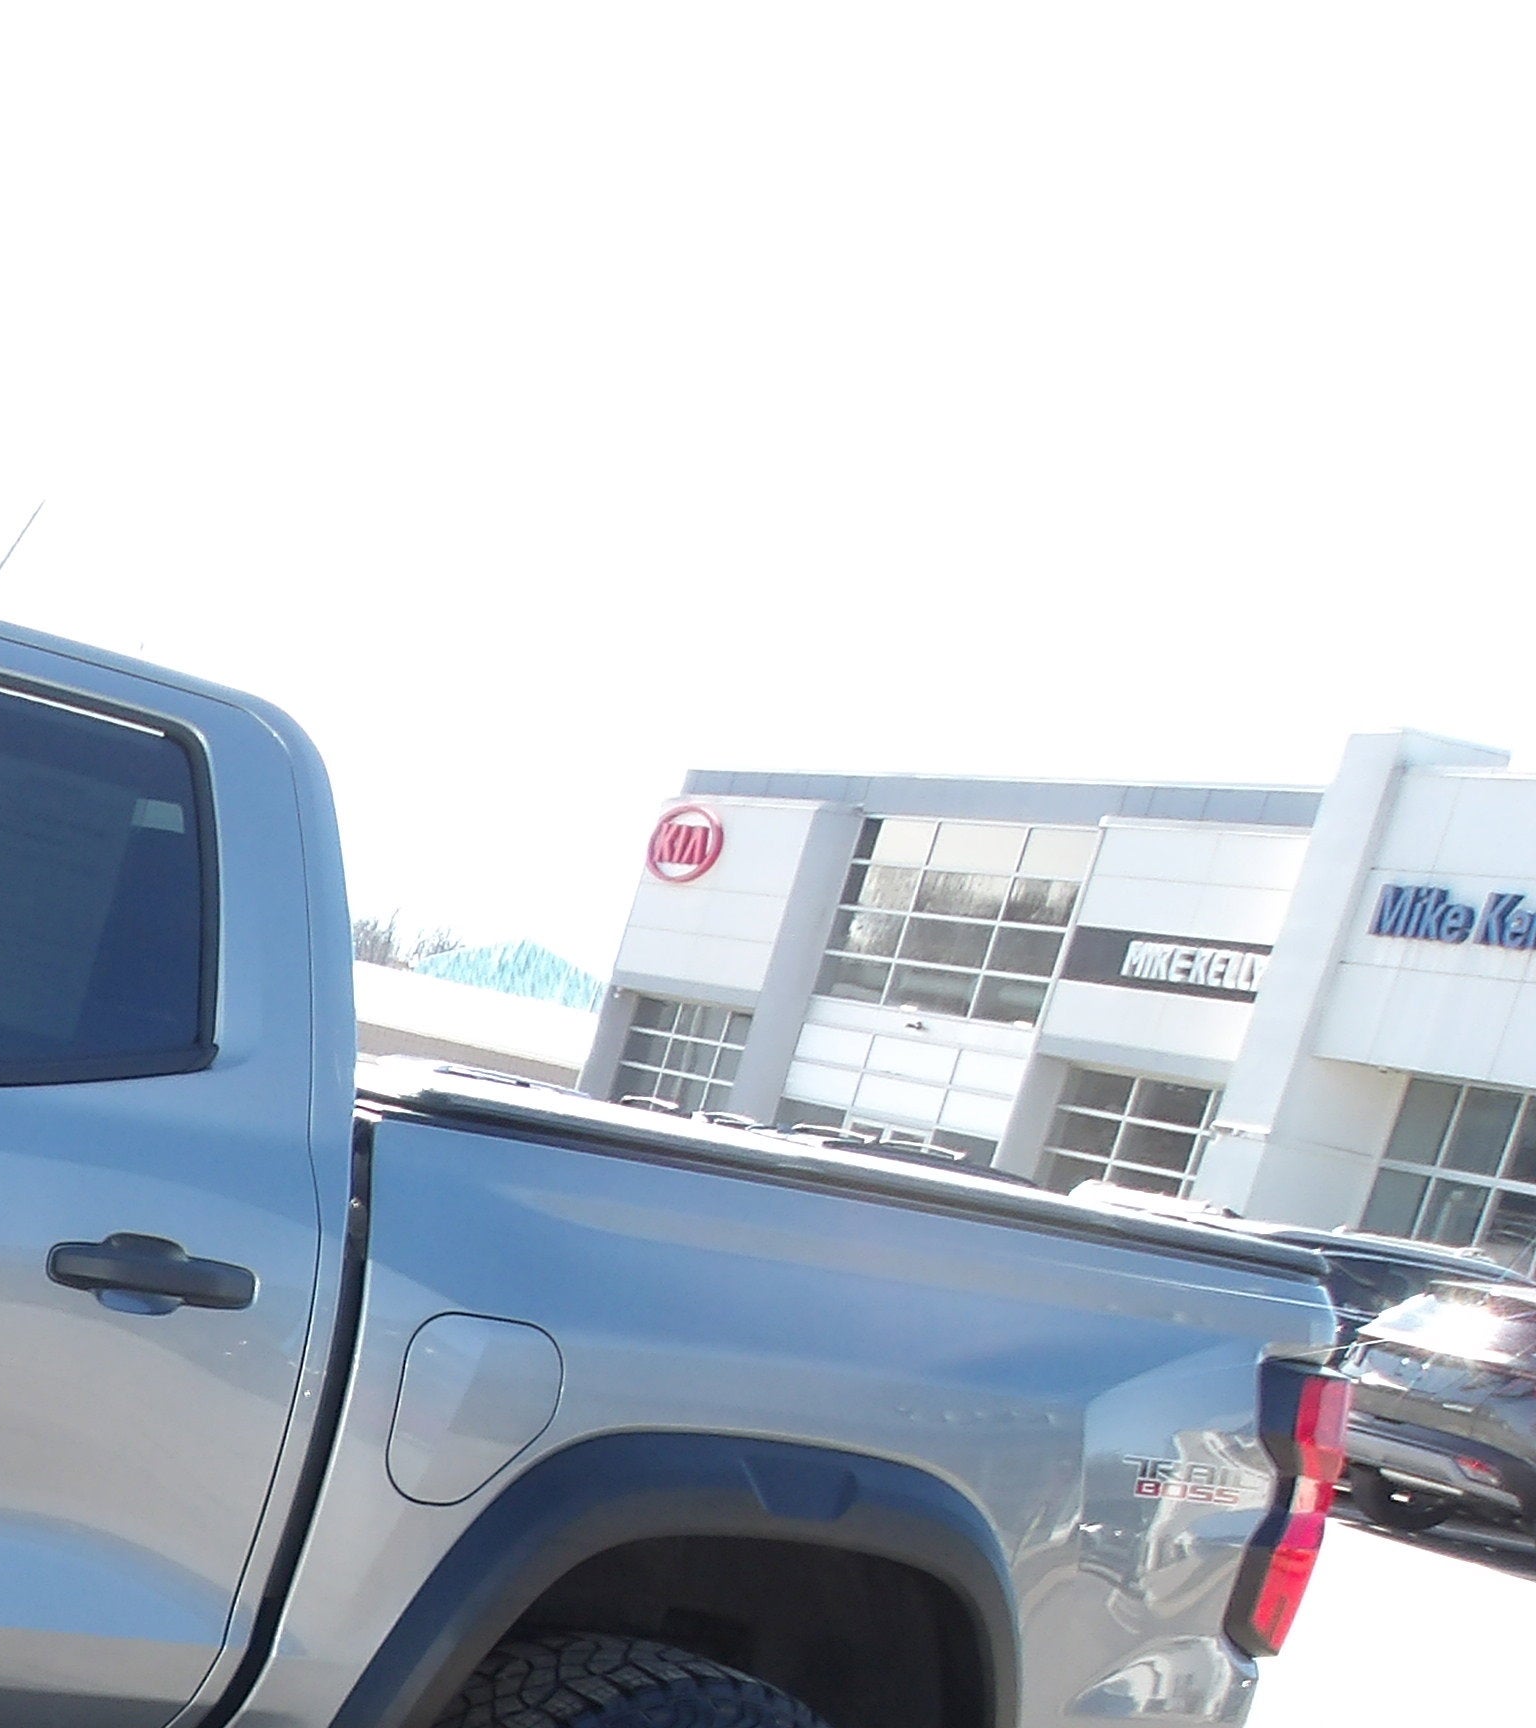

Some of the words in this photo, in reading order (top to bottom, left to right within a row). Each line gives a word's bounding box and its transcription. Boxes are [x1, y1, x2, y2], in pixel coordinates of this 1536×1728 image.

[652, 820, 710, 865] KIA
[1367, 883, 1476, 944] Mike
[1120, 940, 1198, 982] MIKE
[1188, 946, 1272, 992] KELLY
[1123, 1454, 1260, 1492] TRAIL
[1134, 1479, 1241, 1505] BOSS
